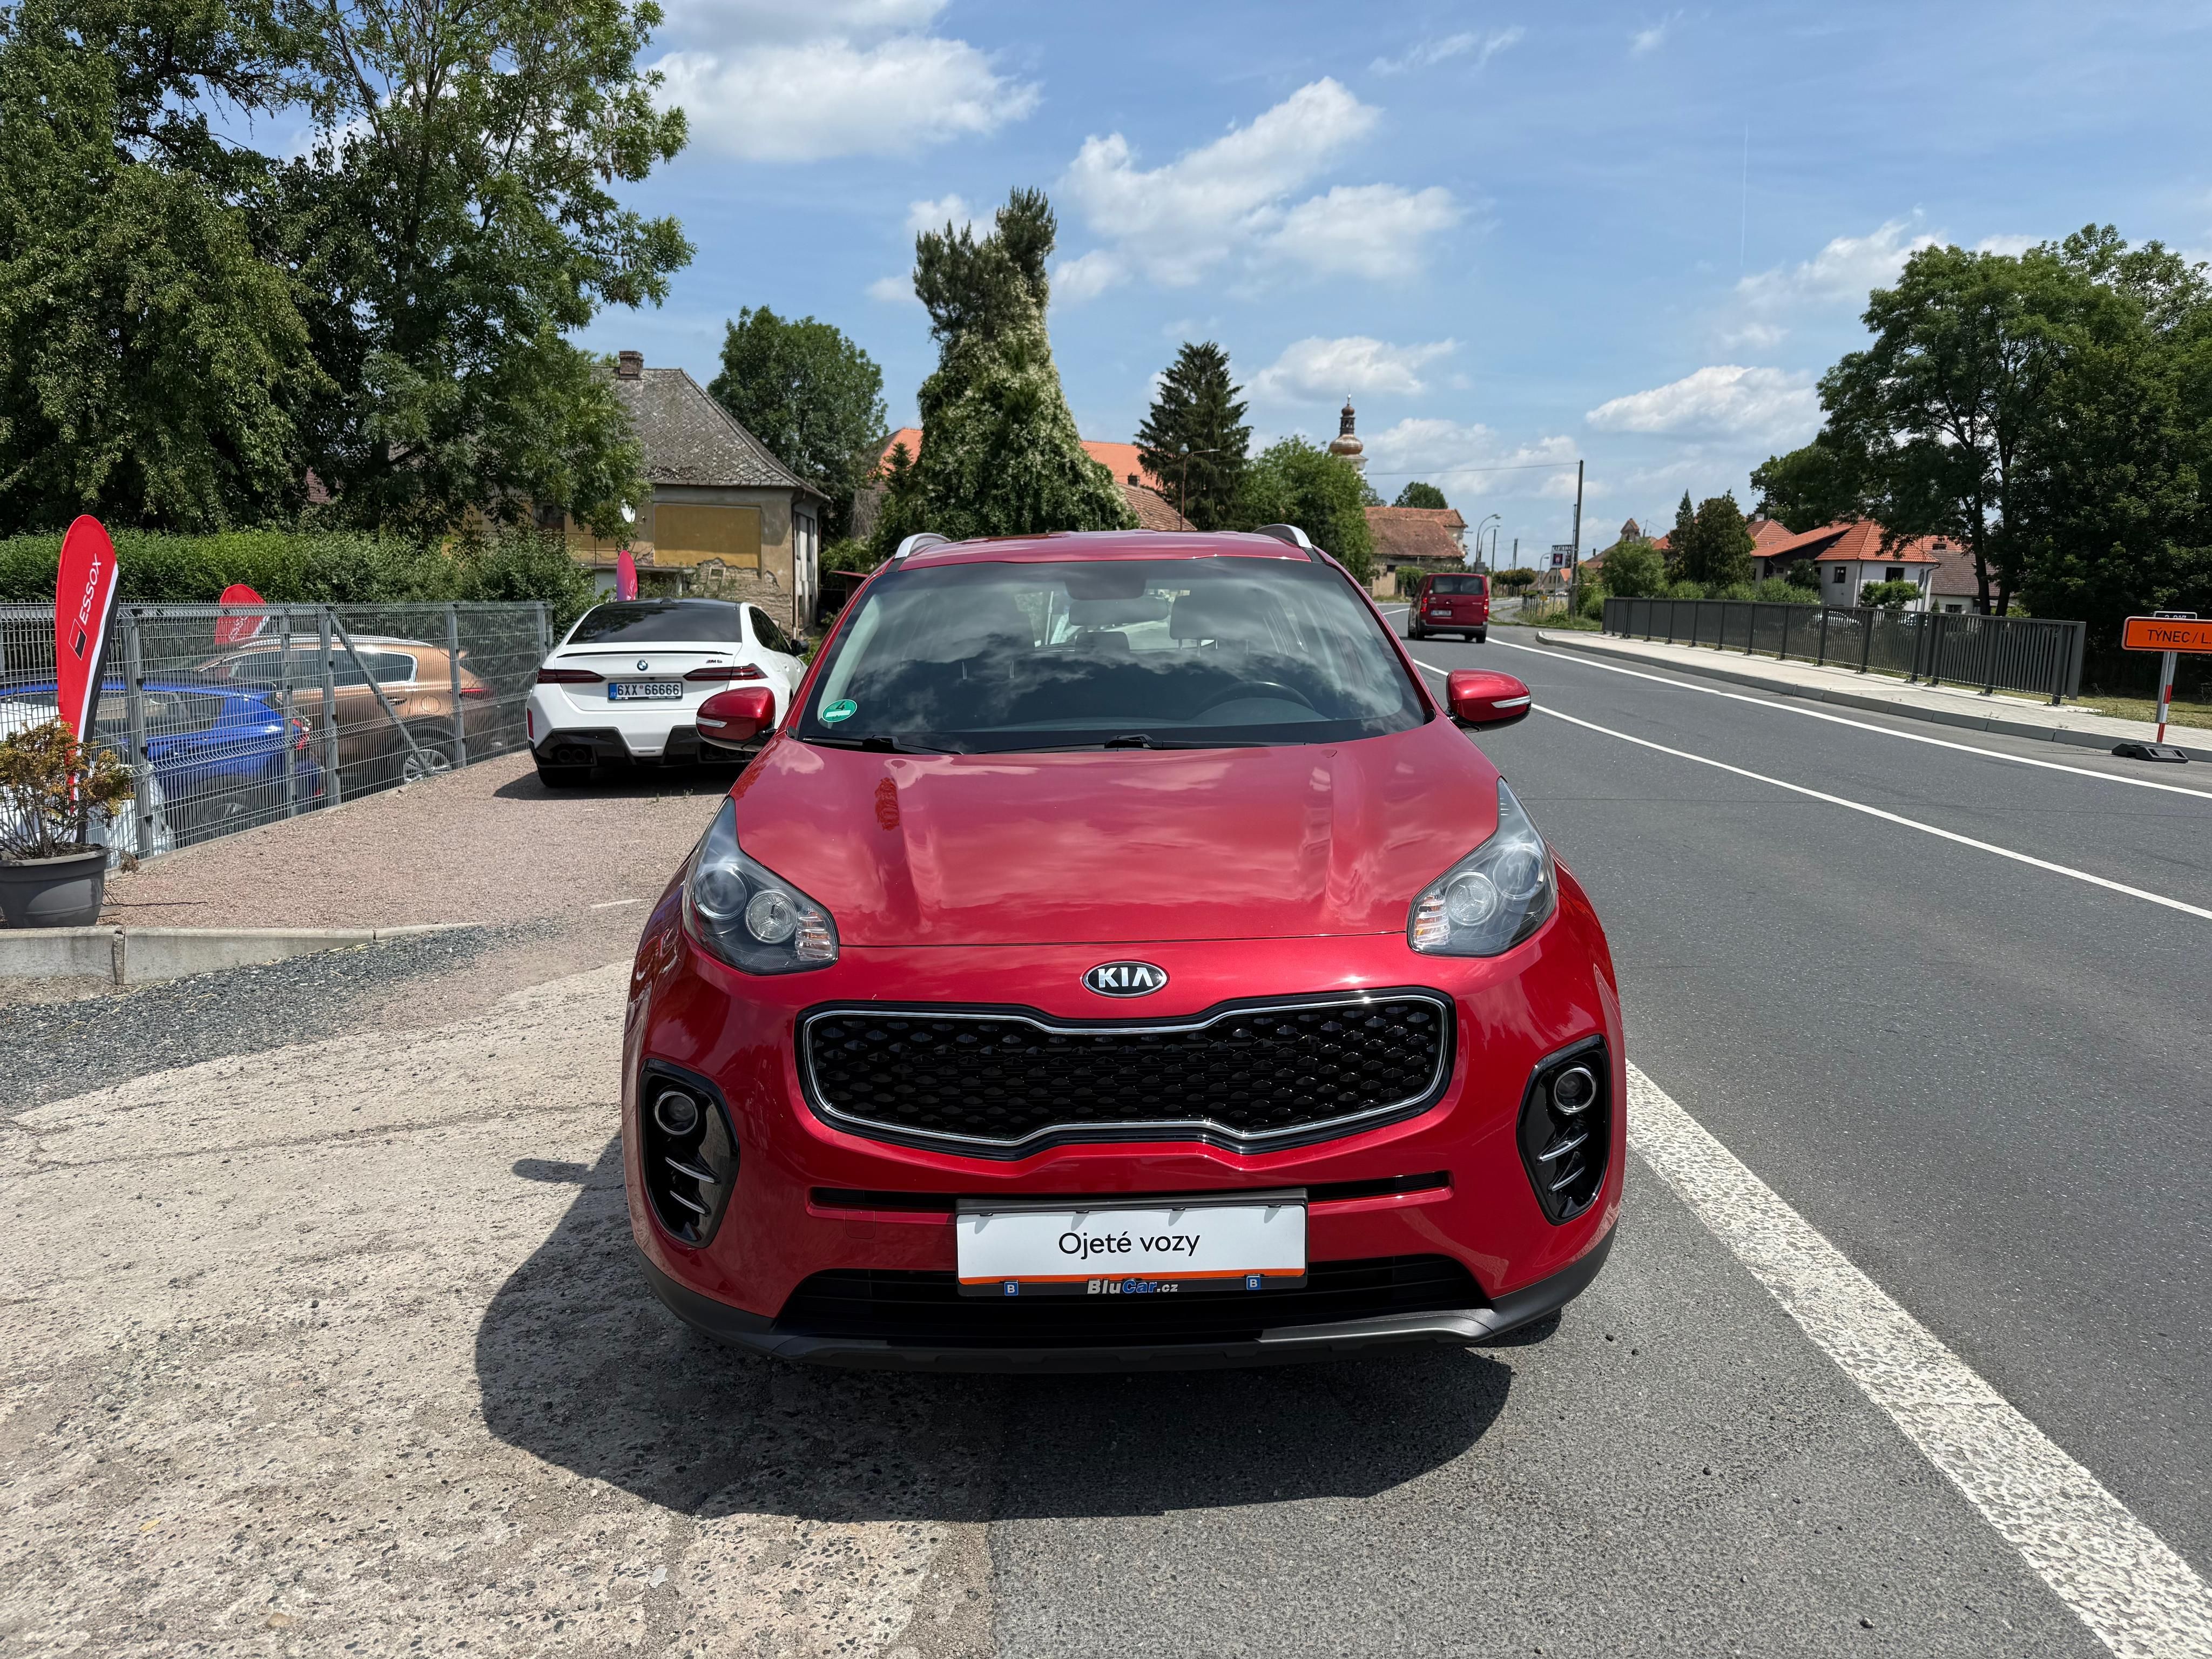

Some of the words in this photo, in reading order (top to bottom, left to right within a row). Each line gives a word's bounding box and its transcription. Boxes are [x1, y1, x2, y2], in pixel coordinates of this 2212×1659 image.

[79, 553, 102, 625] ESSOX
[2147, 627, 2190, 643] TÝNEC
[618, 685, 637, 695] 6XX
[645, 684, 679, 695] 66666
[835, 701, 845, 710] 4
[1098, 967, 1154, 988] KIA
[1058, 1231, 1132, 1260] Ojeté
[1139, 1235, 1200, 1257] vozy
[1007, 1284, 1015, 1293] B
[1087, 1279, 1178, 1294] BluCar.cz
[1250, 1279, 1258, 1287] B
